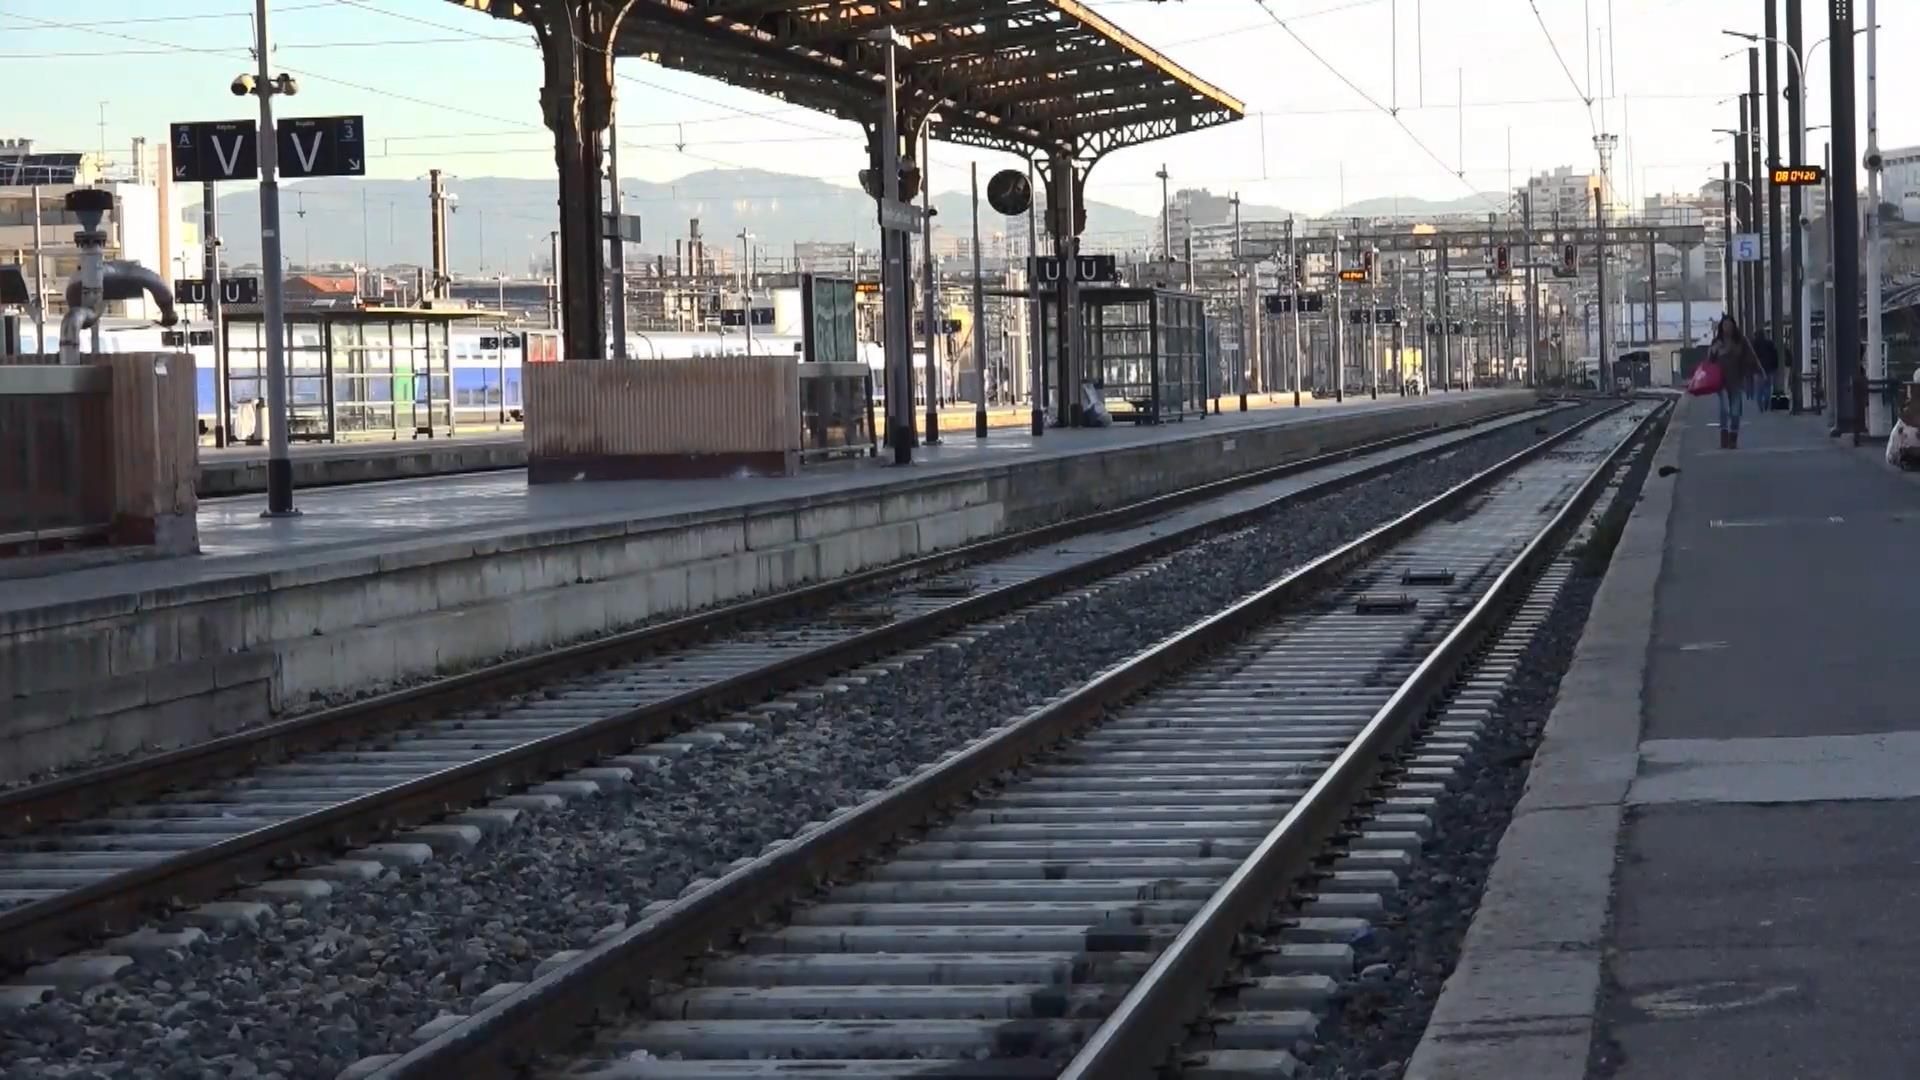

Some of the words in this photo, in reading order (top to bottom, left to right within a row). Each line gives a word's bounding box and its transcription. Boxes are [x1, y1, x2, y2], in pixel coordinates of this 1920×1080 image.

[179, 132, 190, 145] A
[344, 125, 354, 139] 3
[211, 135, 244, 176] V
[291, 131, 323, 173] V
[1775, 171, 1788, 182] 08
[1739, 240, 1752, 259] 5
[1046, 261, 1060, 280] U
[1082, 260, 1096, 280] U
[191, 284, 205, 302] U
[226, 283, 239, 302] U
[1278, 299, 1287, 312] T
[1301, 299, 1310, 311] T
[733, 313, 742, 324] T
[755, 311, 763, 323] T
